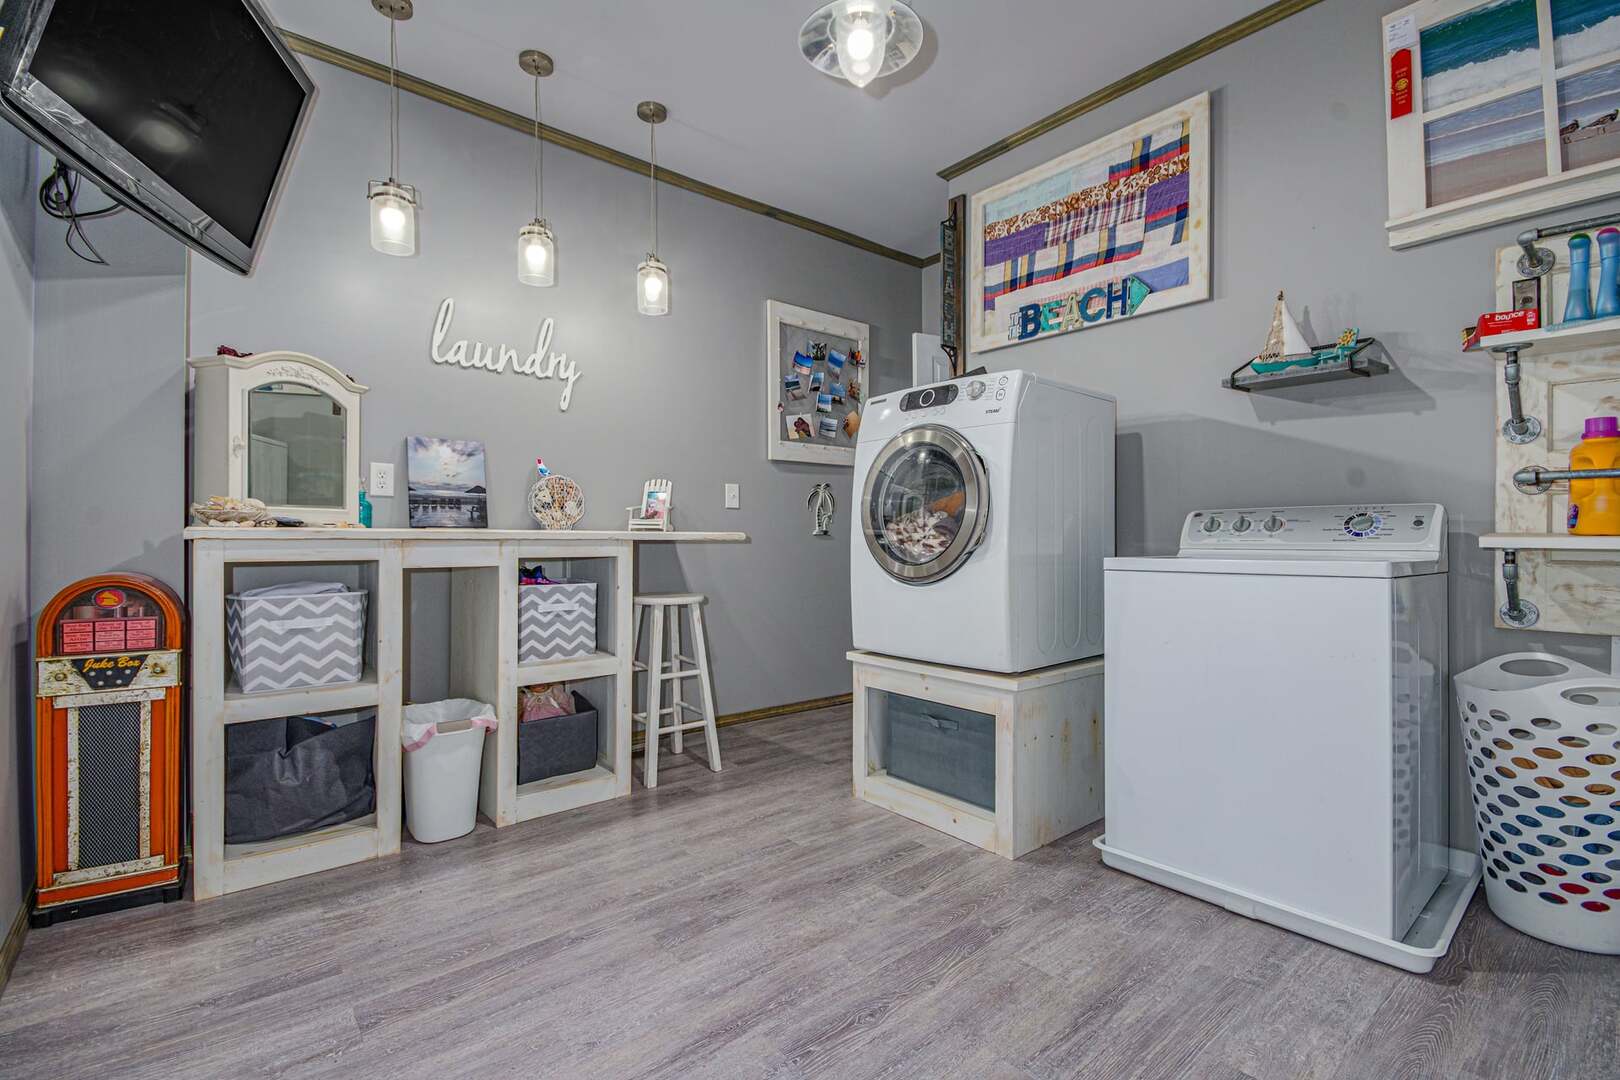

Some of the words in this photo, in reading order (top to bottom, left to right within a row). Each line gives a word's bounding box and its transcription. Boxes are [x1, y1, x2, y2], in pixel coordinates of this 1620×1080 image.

[1018, 277, 1129, 341] BEACH
[1494, 311, 1525, 321] bounce
[431, 298, 583, 412] laundry
[83, 658, 115, 672] Juke
[115, 656, 141, 668] Box
